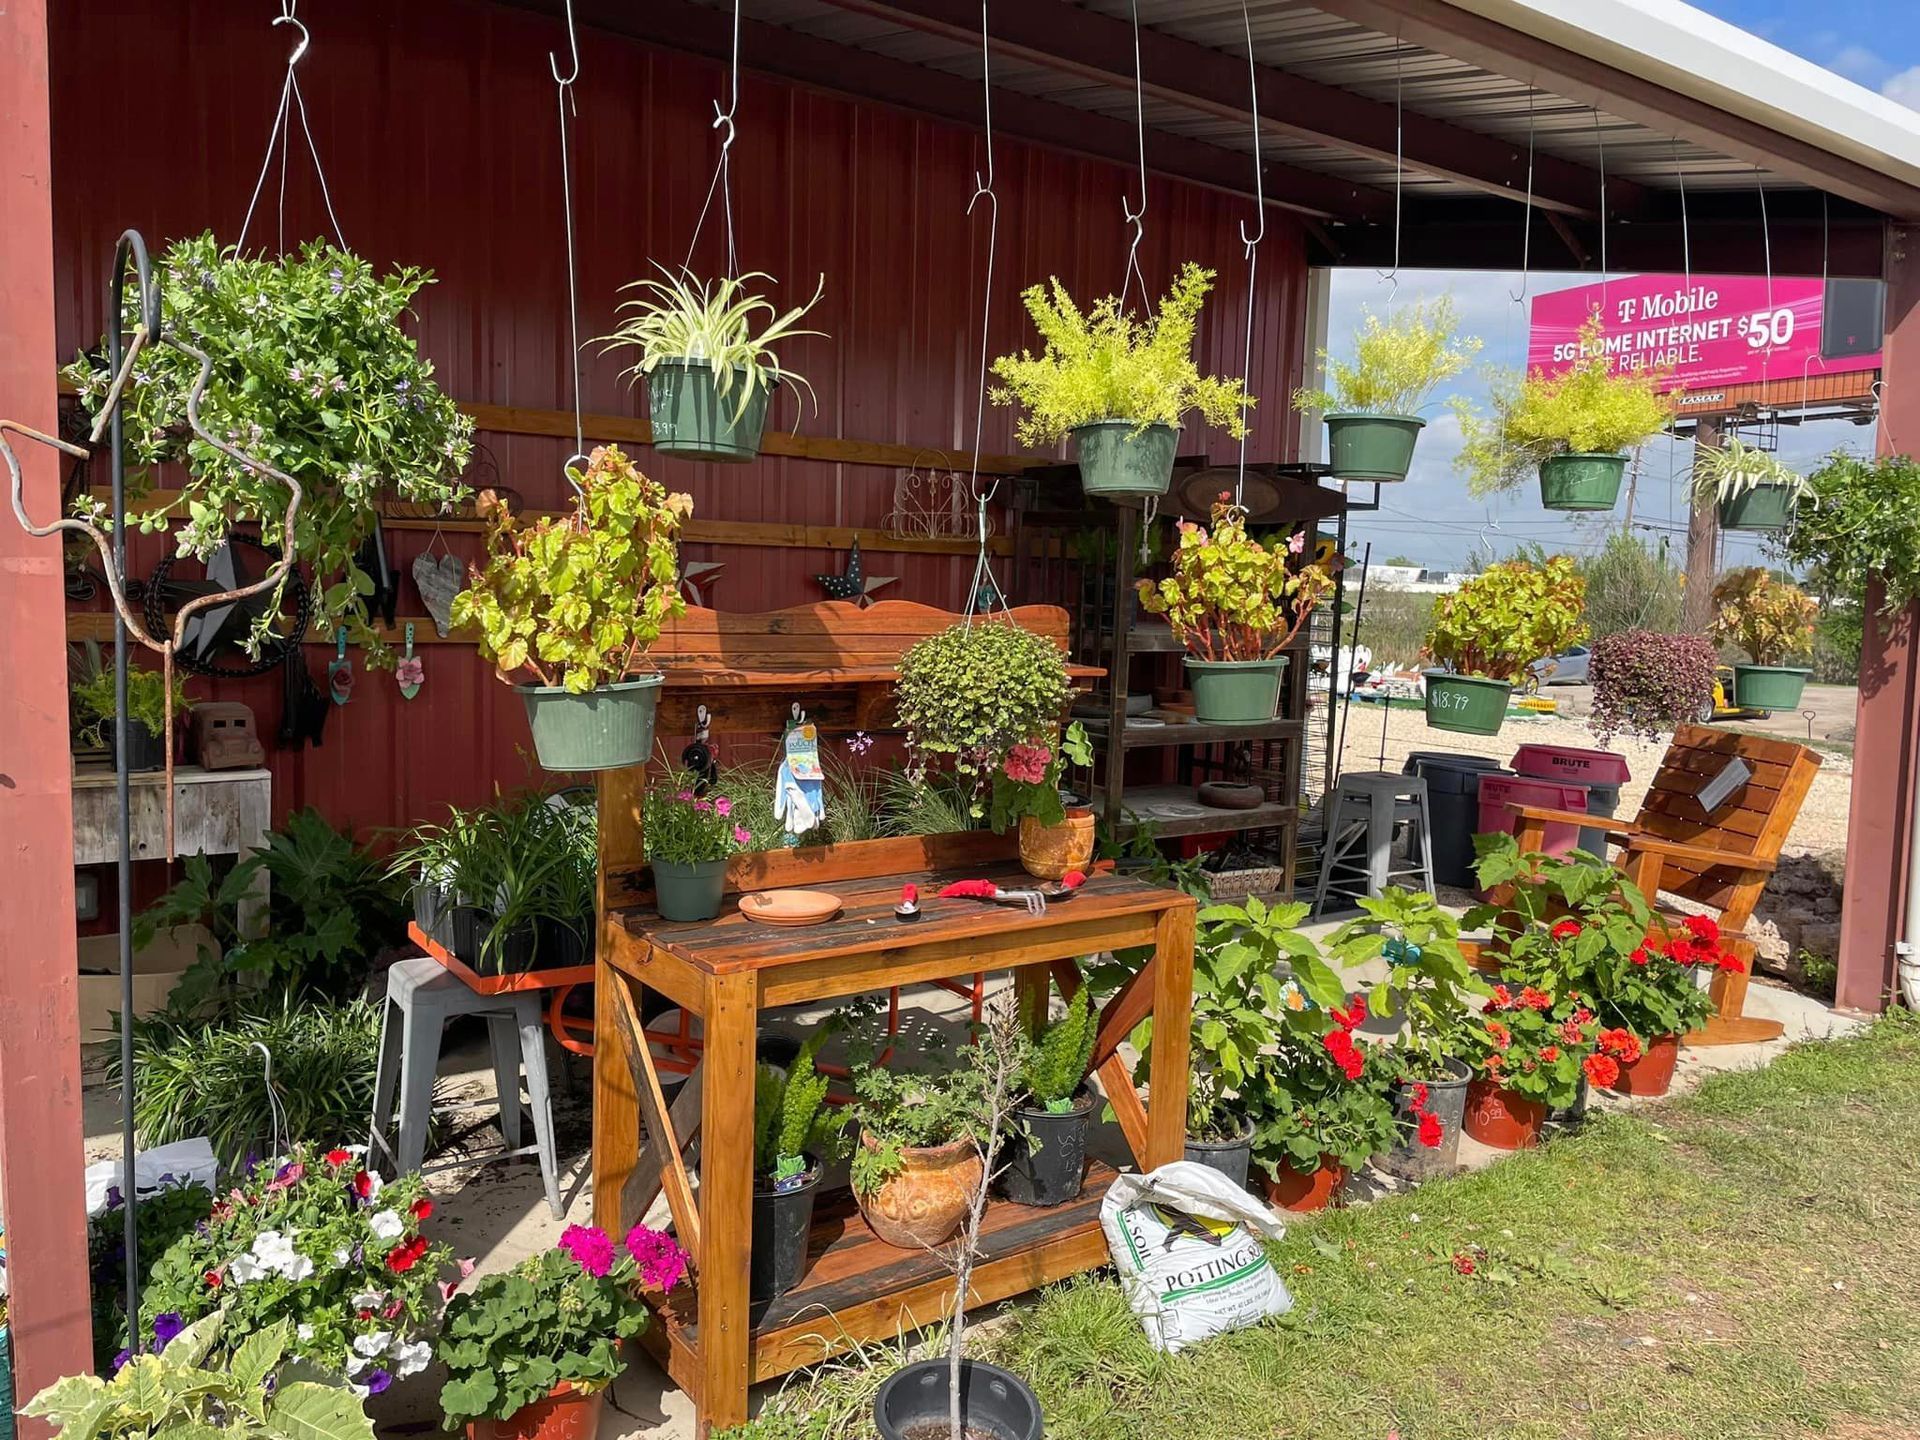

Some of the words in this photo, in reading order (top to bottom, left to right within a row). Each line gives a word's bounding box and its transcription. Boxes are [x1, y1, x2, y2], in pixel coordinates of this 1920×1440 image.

[1641, 286, 1718, 321] Mobile
[1553, 342, 1576, 362] 5G
[1636, 317, 1733, 350] INTERNET
[1737, 308, 1795, 348] $50
[1619, 344, 1703, 372] RELIABLE.
[1431, 688, 1470, 711] $18.99
[1552, 757, 1591, 769] BRUTE
[1129, 1226, 1152, 1260] SOIL
[1165, 1249, 1247, 1292] POTTING
